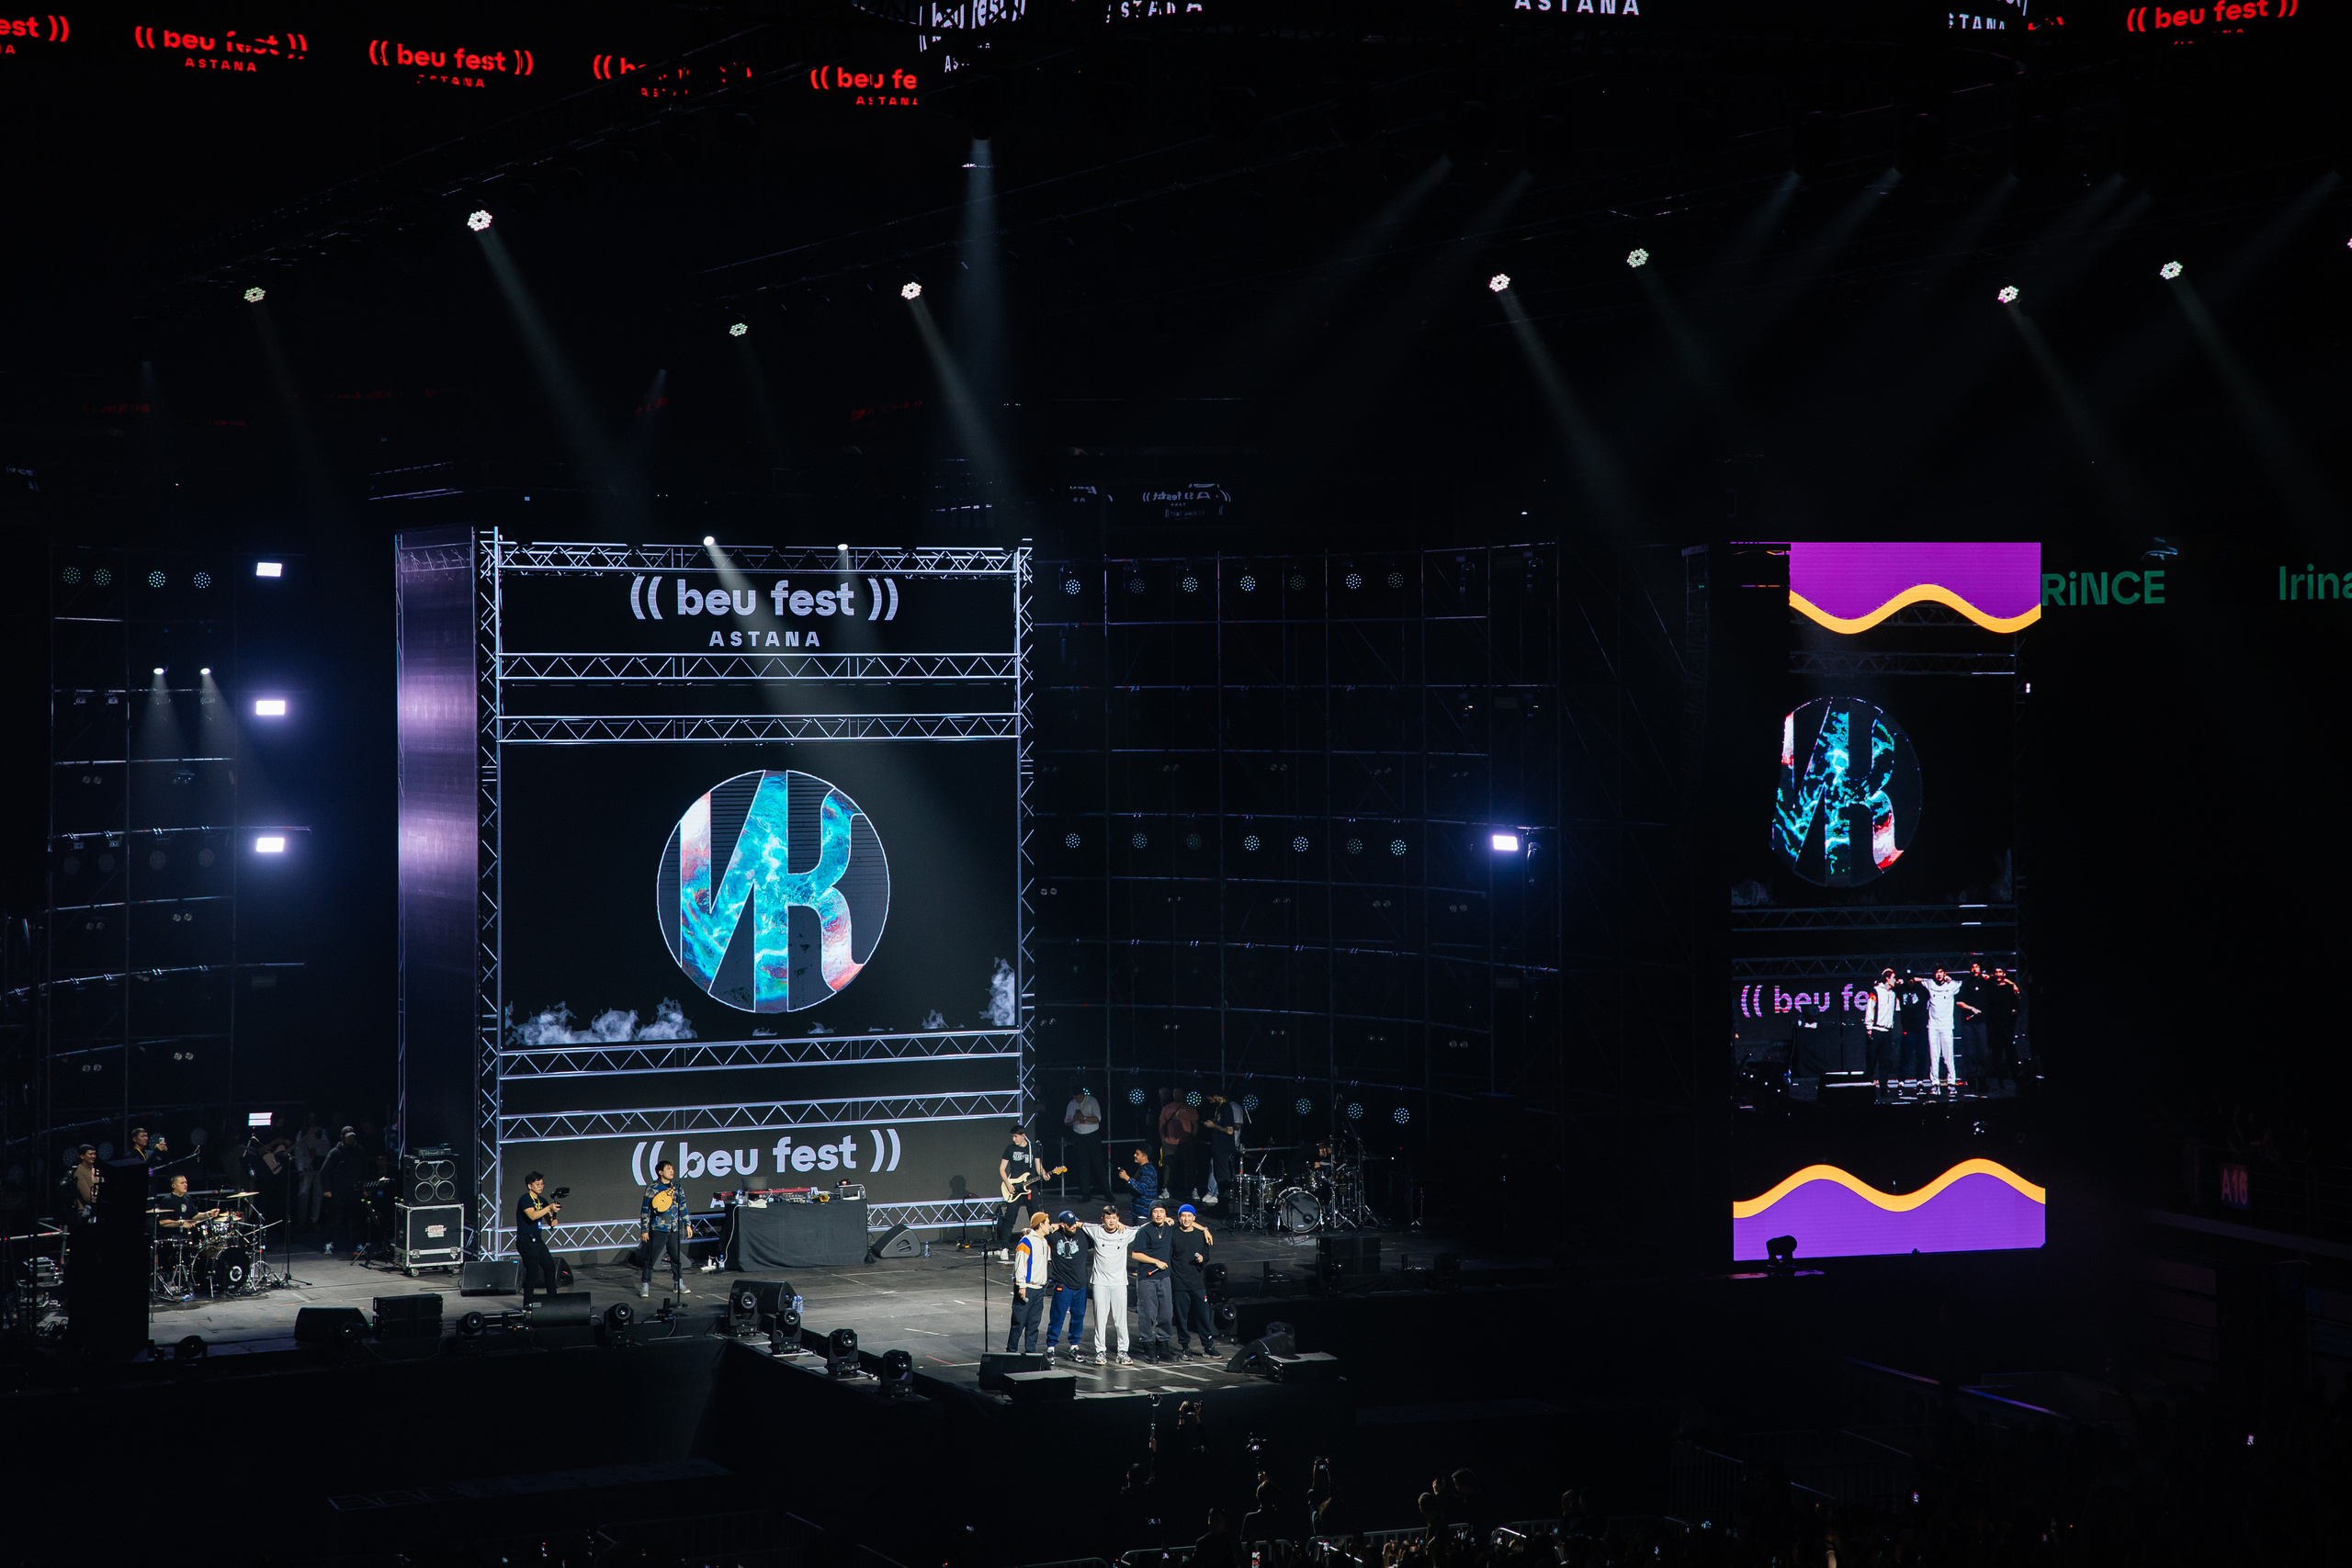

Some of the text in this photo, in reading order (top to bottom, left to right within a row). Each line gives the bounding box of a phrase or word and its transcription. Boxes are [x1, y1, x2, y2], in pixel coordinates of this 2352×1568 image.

[2155, 7, 2205, 29] beu
[2214, 0, 2268, 22] fest
[164, 30, 215, 51] beu
[185, 57, 256, 73] ASTANA
[397, 43, 446, 68] beu
[454, 48, 505, 72] fest
[837, 67, 885, 89] beu
[677, 579, 757, 616] beu
[771, 580, 854, 616] fest
[709, 631, 820, 647] ASTANA
[1774, 986, 1831, 1013] beu
[679, 1142, 759, 1179] beu
[773, 1135, 857, 1173] fest
